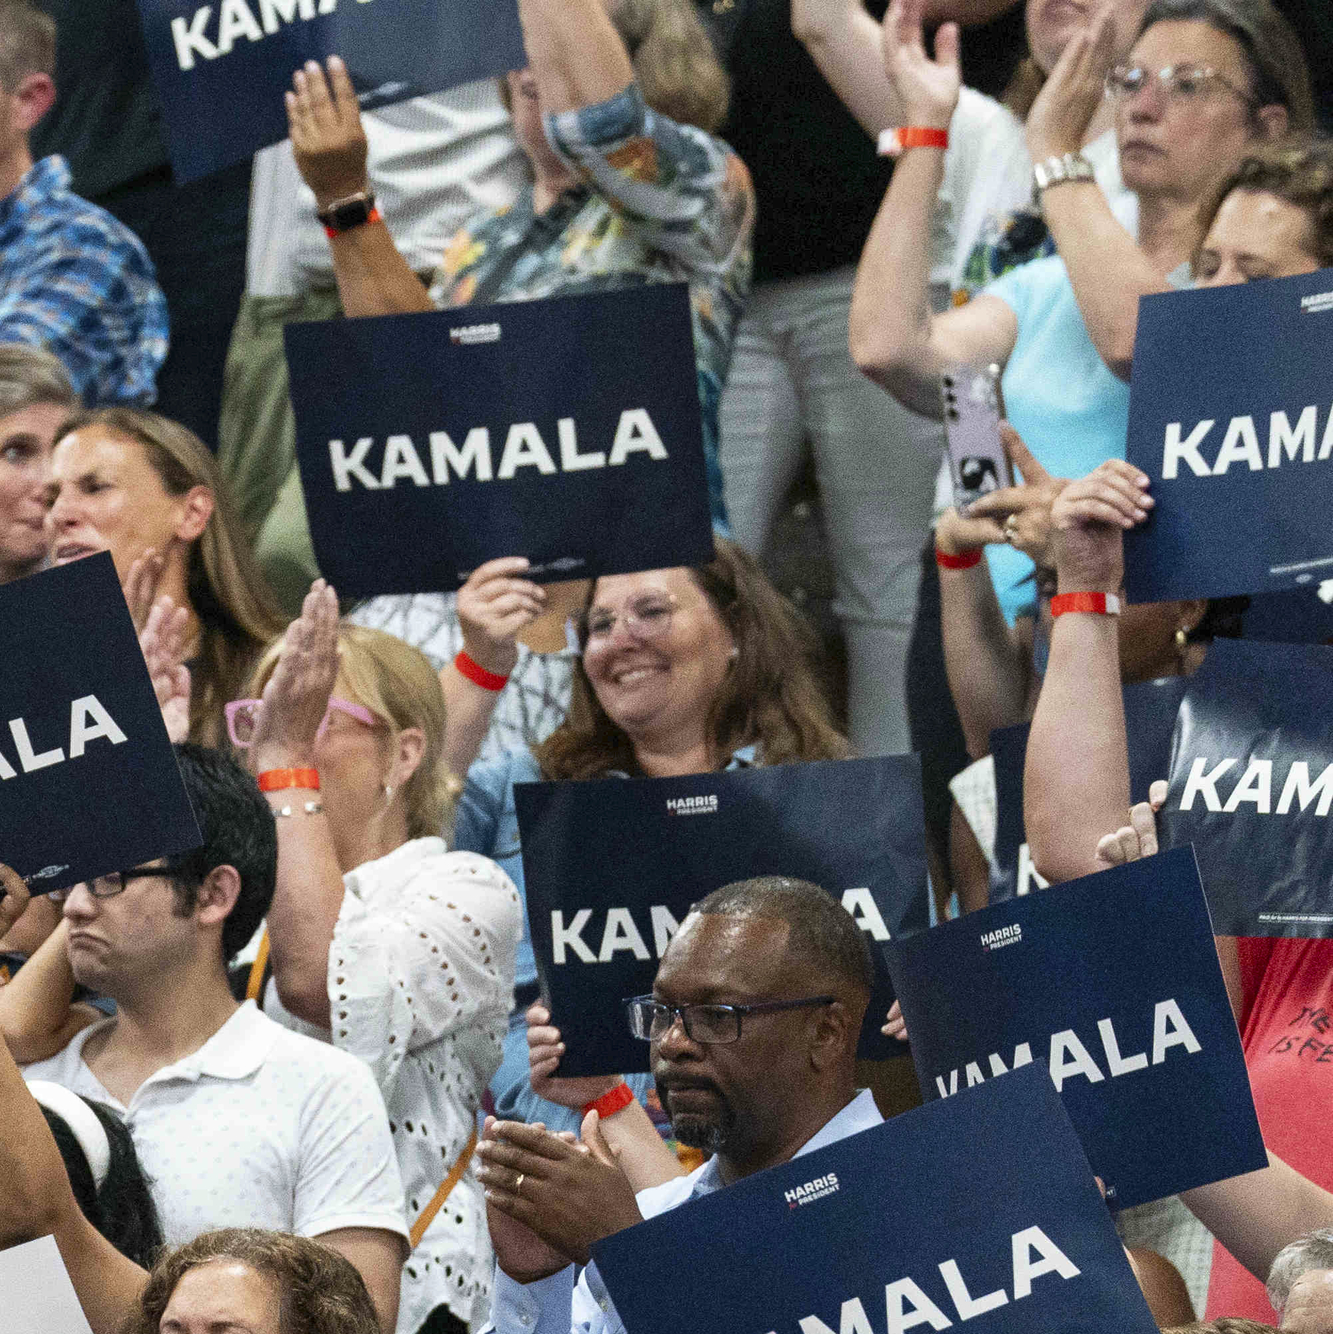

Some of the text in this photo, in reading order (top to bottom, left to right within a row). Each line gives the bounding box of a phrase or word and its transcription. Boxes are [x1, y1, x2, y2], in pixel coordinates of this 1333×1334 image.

[329, 408, 668, 491] KAMALA
[666, 795, 718, 810] HARRIS
[980, 923, 1021, 946] HARRIS
[784, 1173, 838, 1202] HARRIS
